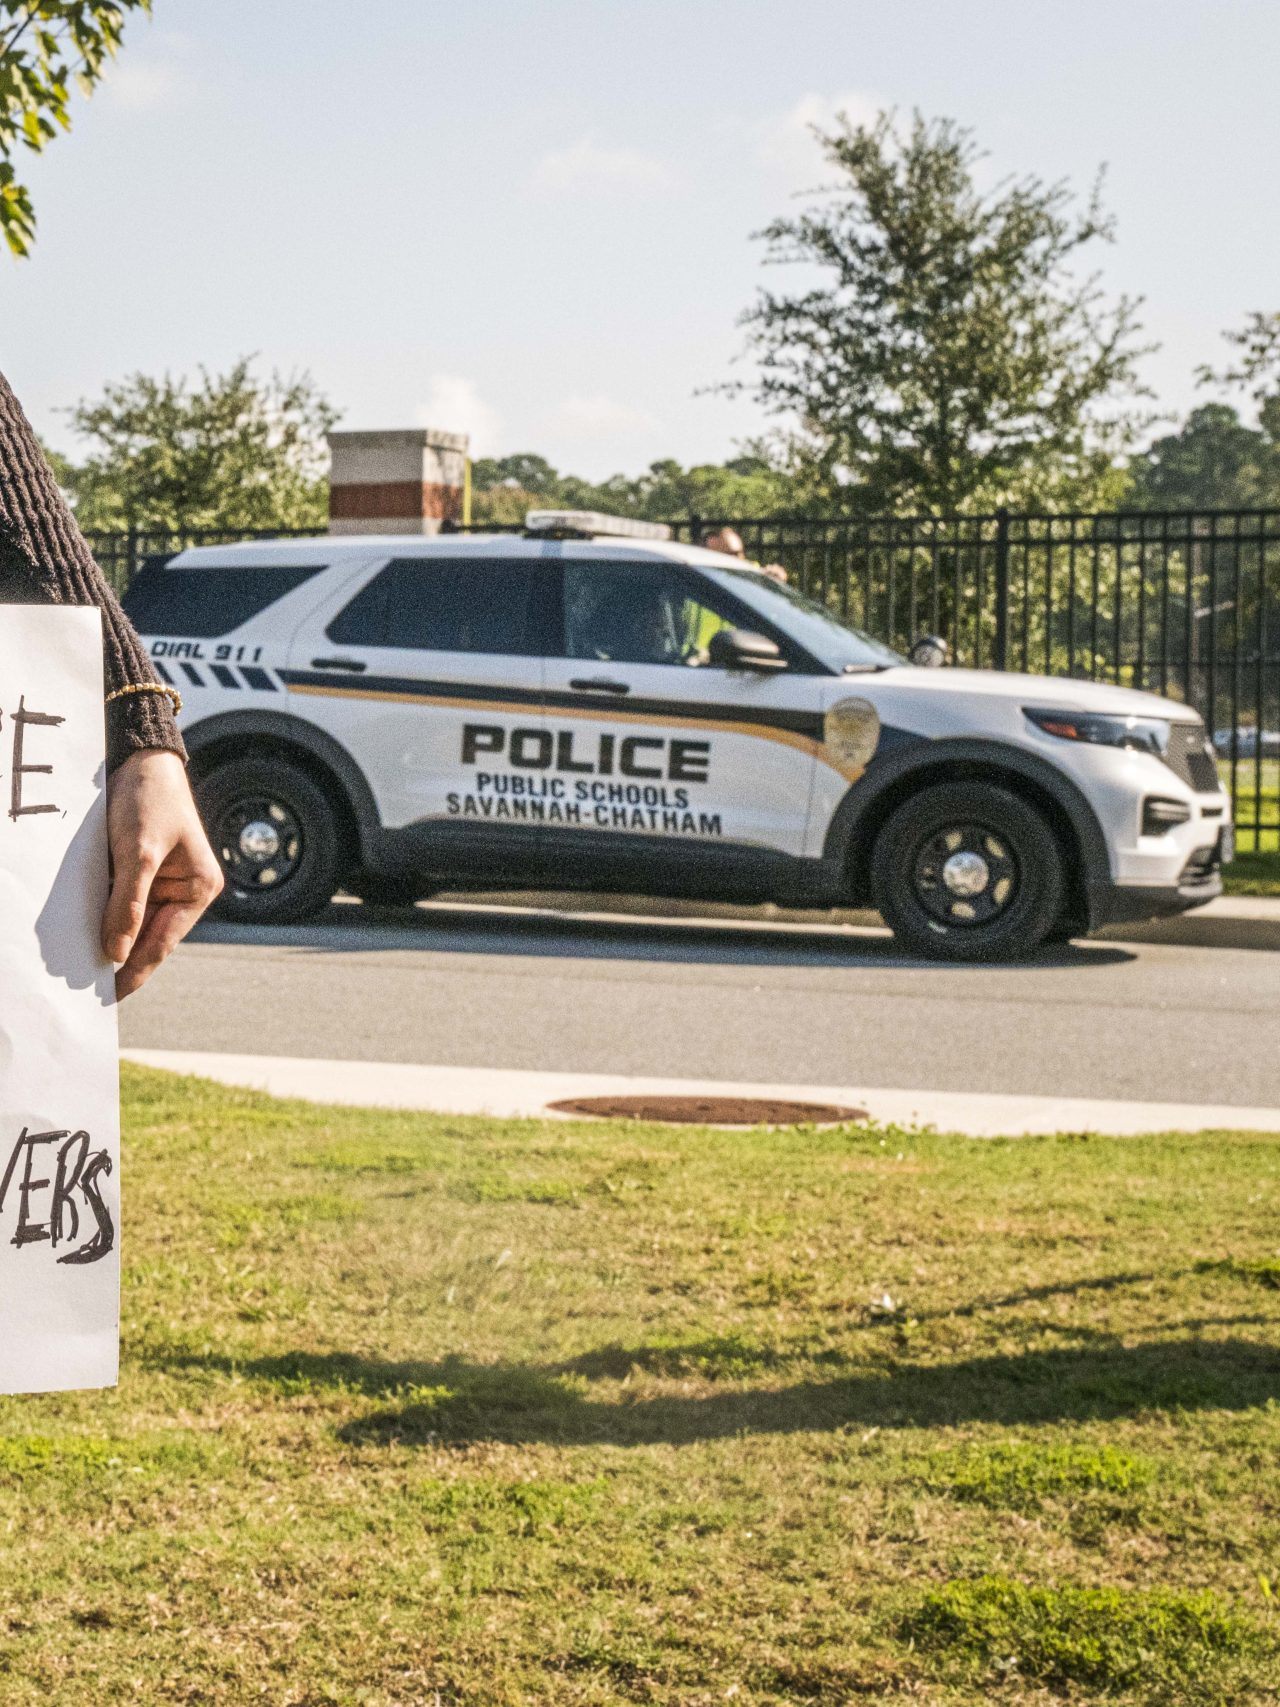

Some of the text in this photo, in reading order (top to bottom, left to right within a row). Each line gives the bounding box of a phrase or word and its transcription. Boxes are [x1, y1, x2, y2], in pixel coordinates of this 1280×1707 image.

[151, 641, 262, 662] DIAL 911
[461, 723, 710, 782] POLICE
[477, 772, 689, 809] PUBLIC SCHOOLS
[447, 792, 722, 836] SAVANNAH-CHATHAM
